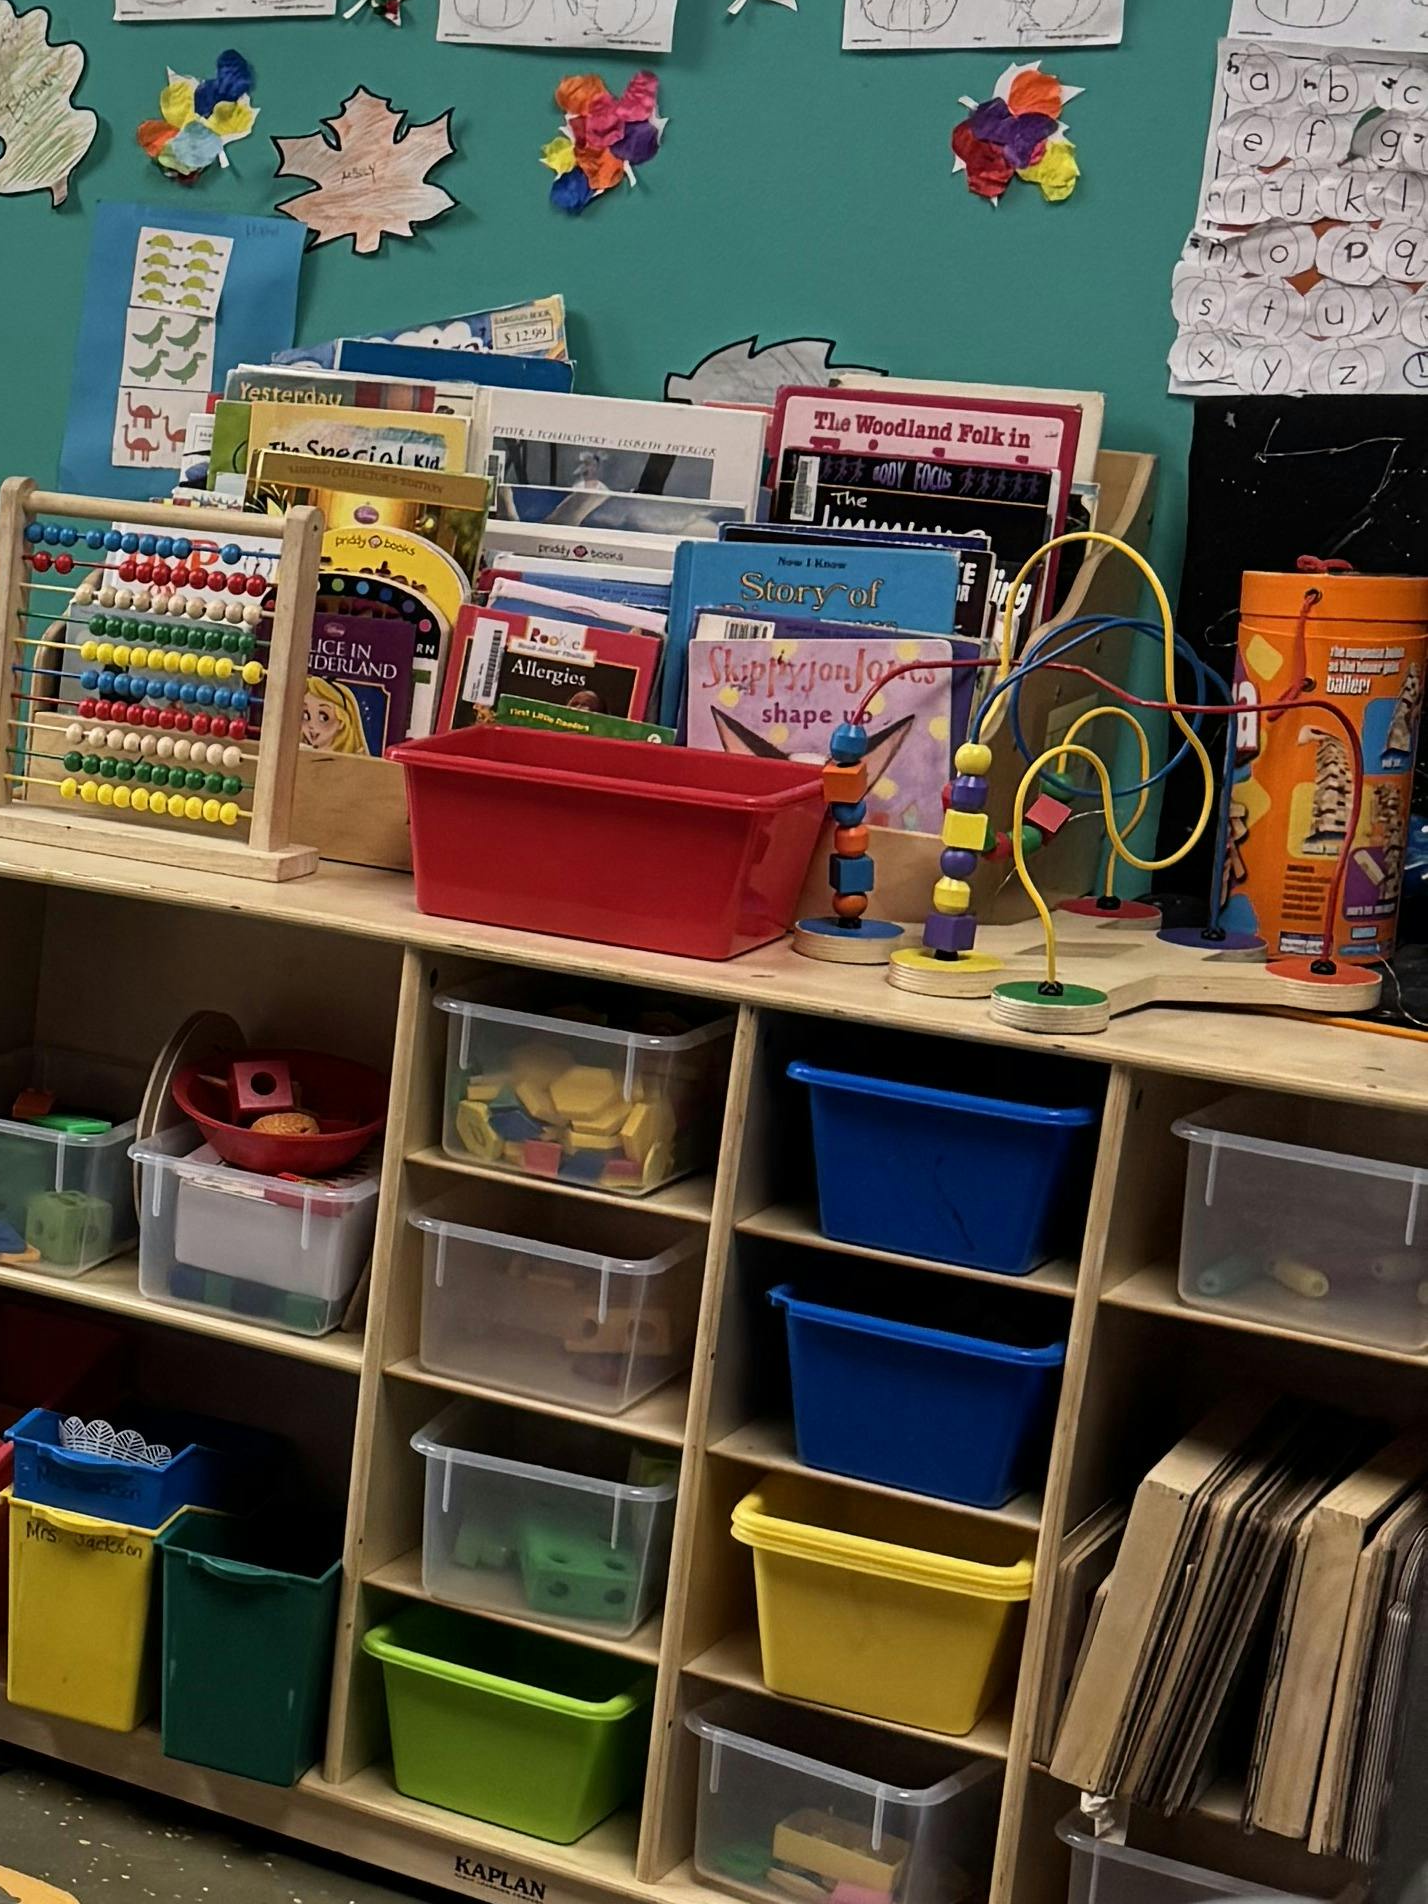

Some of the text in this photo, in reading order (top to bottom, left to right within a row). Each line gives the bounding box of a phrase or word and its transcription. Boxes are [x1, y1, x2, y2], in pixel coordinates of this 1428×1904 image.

[1249, 69, 1423, 105] a b c
[1243, 119, 1402, 163] e f g
[1286, 176, 1364, 216] j k
[1269, 239, 1418, 277] o p q
[1199, 298, 1389, 326] s t u v
[515, 326, 548, 344] 12.99
[1197, 350, 1359, 390] x y z
[239, 381, 342, 406] Yesterday
[814, 410, 1032, 449] The Woodland Folk in
[306, 439, 404, 468] Special
[873, 461, 953, 490] BODY FOCUS
[831, 491, 868, 509] The
[336, 535, 417, 556] priddy books
[538, 544, 624, 562] priddy books
[777, 555, 801, 568] Now
[815, 558, 848, 570] Know
[740, 571, 885, 611] Story of
[351, 643, 372, 660] IN
[511, 659, 587, 687] Allergies
[510, 707, 531, 718] First
[762, 701, 833, 725] shape
[73, 1534, 143, 1559] Jackson
[455, 1856, 547, 1900] KAPLAN
